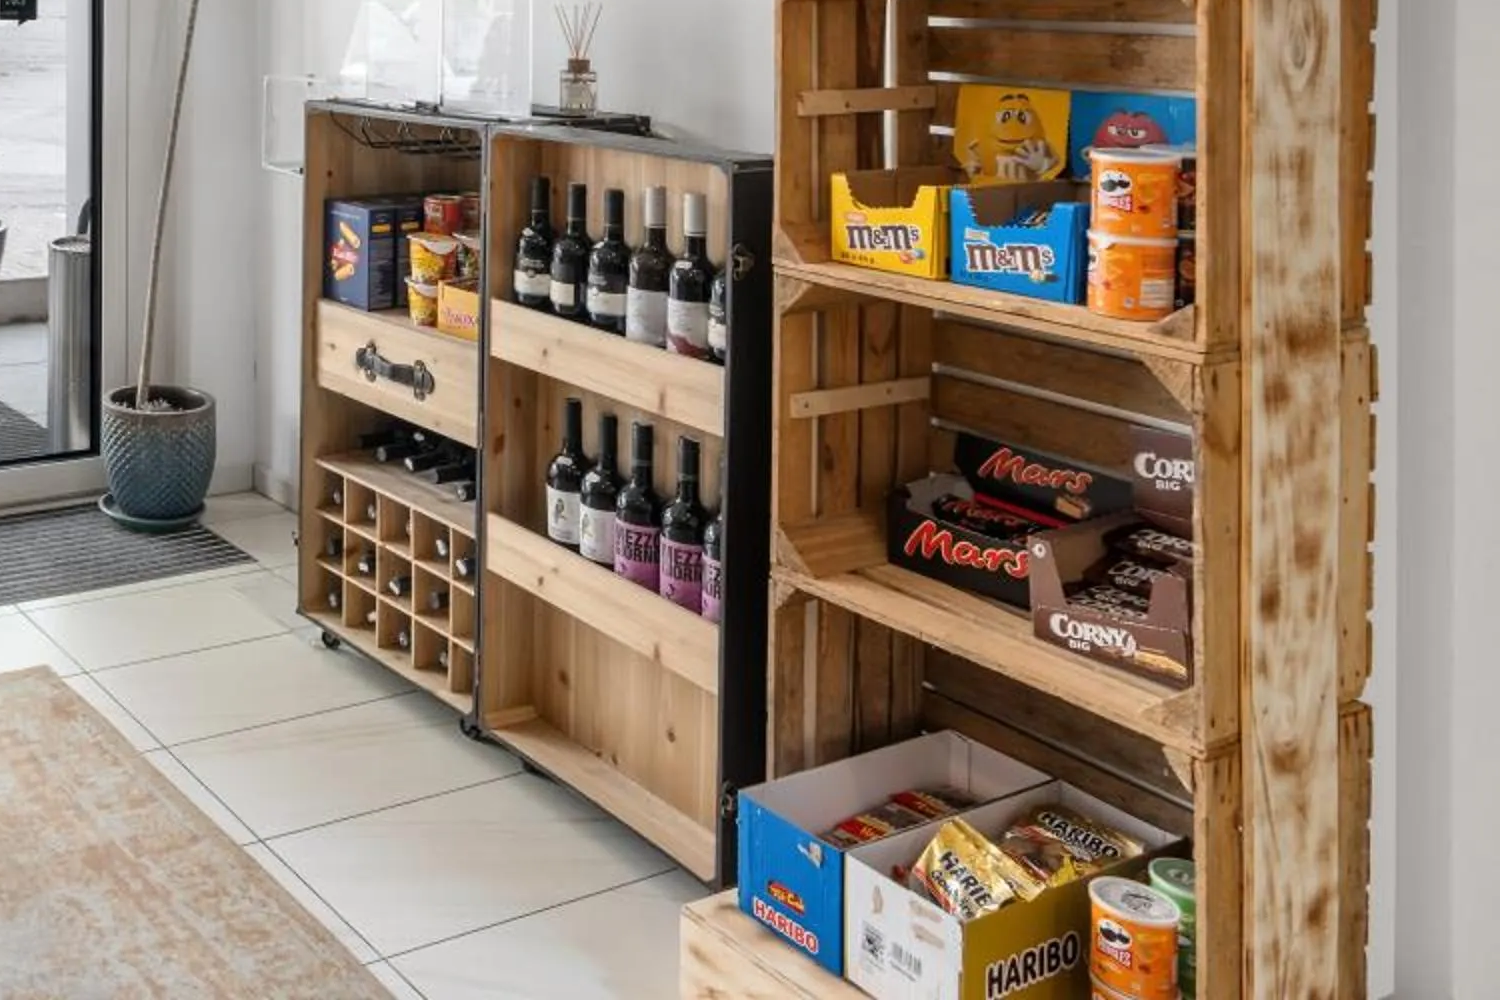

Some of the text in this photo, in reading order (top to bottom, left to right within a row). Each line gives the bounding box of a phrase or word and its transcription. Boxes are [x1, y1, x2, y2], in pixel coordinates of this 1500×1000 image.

[977, 448, 1094, 494] Mars
[1133, 452, 1195, 481] COR
[1155, 480, 1182, 491] BIG
[904, 519, 1030, 579] Mars
[1049, 612, 1132, 650] CORNY
[1068, 638, 1092, 651] BIG
[1041, 812, 1119, 859] HARIBO
[939, 850, 993, 907] HARIB
[754, 899, 819, 954] HARIBO
[987, 932, 1080, 999] HARIBO
